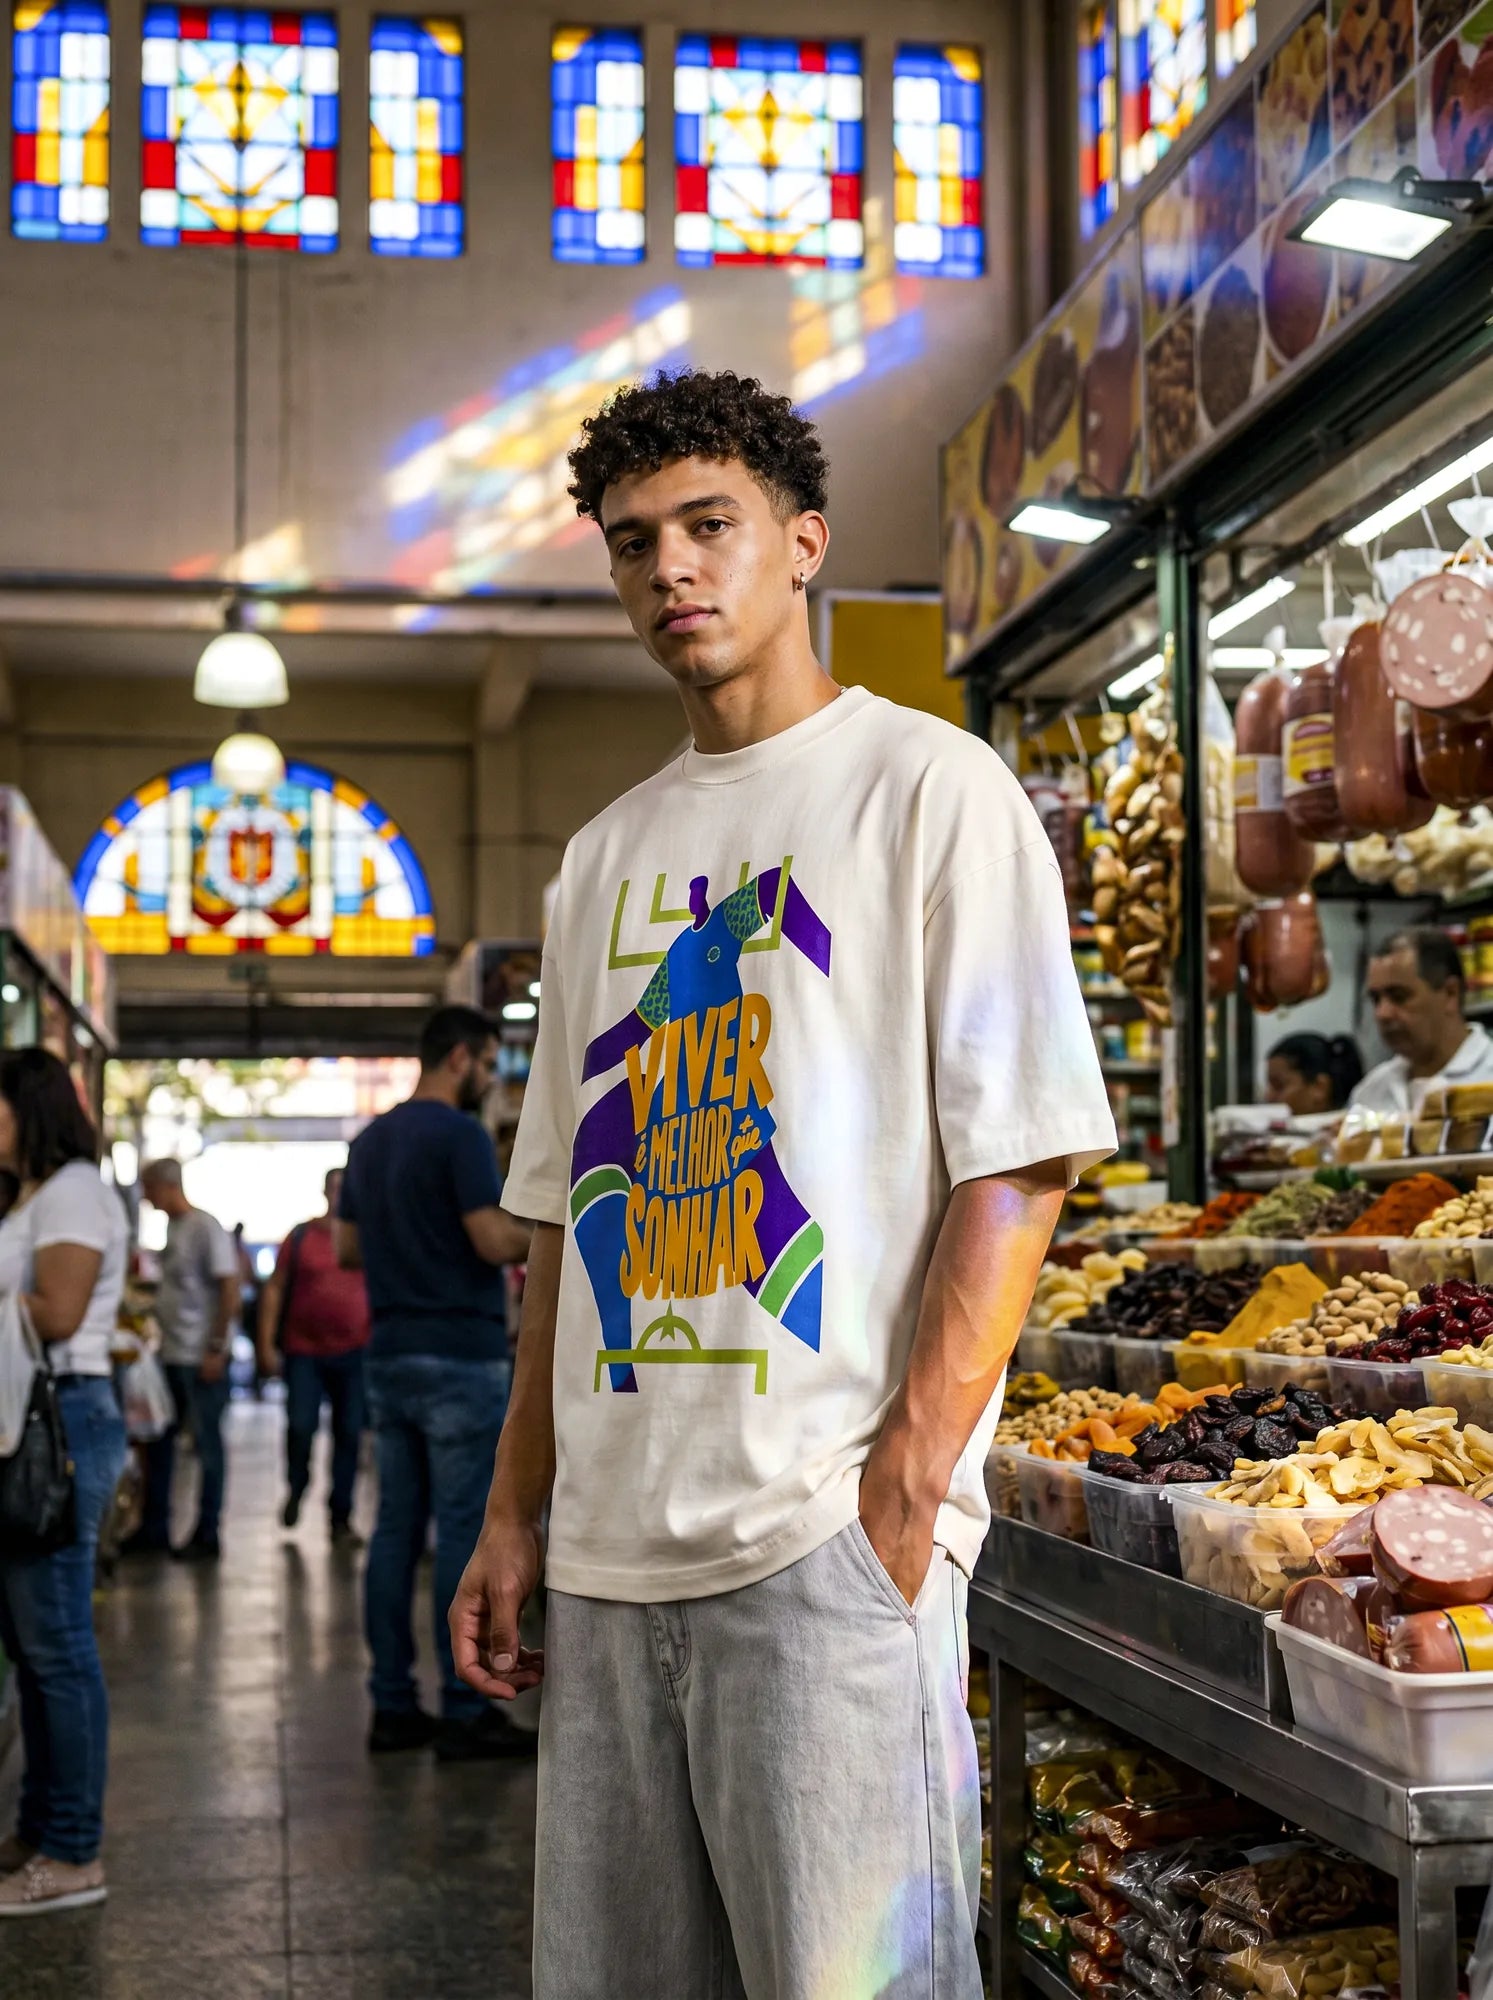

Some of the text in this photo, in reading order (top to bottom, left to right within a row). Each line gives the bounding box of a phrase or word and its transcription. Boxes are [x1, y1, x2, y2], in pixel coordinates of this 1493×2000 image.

[624, 993, 775, 1136] VIVER
[648, 1104, 732, 1195] MELHOR
[730, 1126, 763, 1169] que
[619, 1168, 767, 1300] SONHAR
